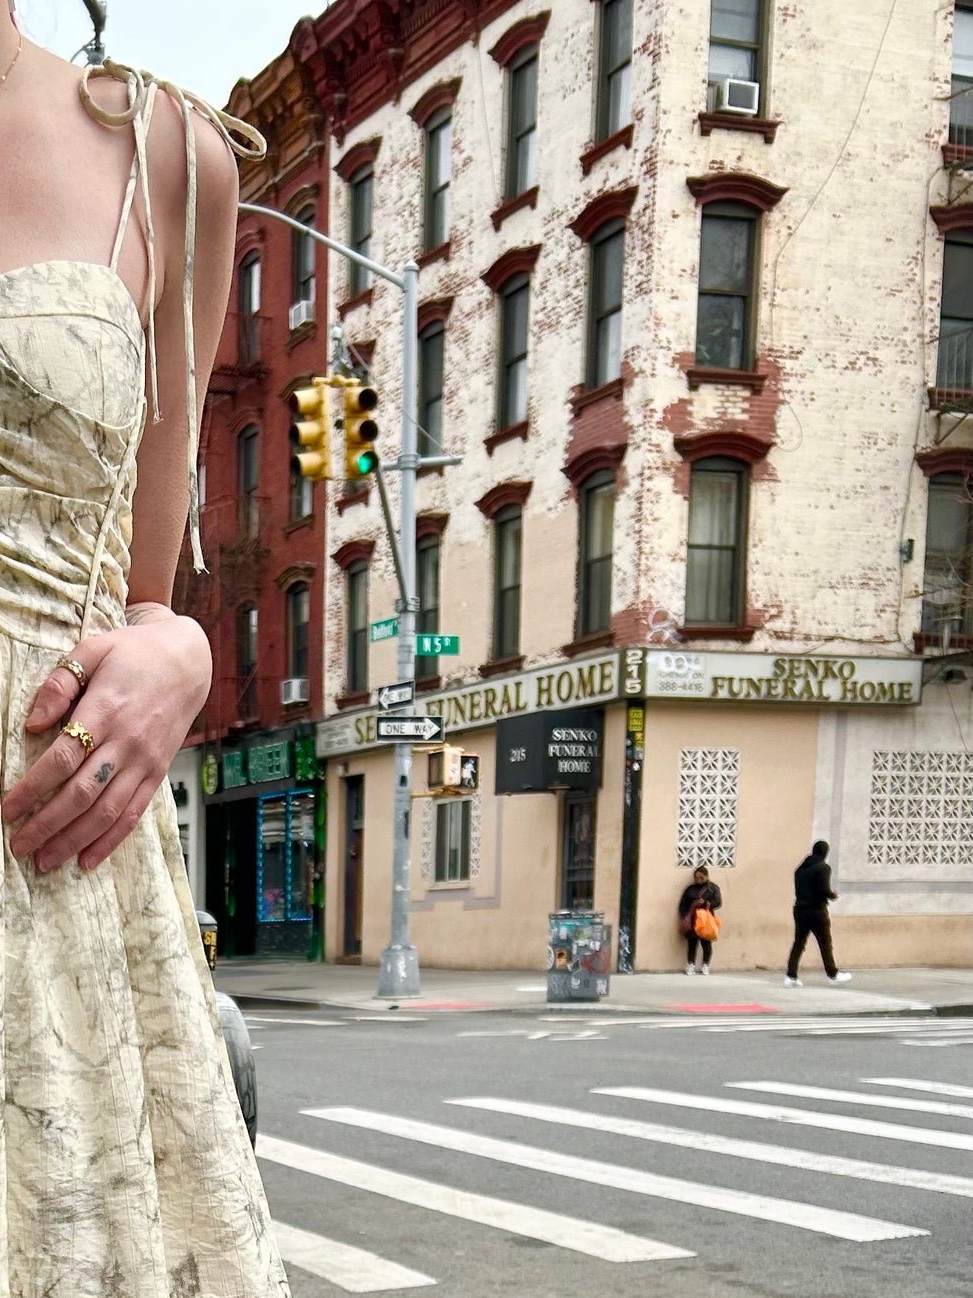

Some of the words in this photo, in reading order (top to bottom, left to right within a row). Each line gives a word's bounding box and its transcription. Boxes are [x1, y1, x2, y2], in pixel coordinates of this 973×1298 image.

[433, 637, 442, 653] 5
[773, 657, 857, 681] SENKO
[536, 660, 615, 707] HOME
[711, 676, 831, 701] FUNERAL
[840, 680, 914, 702] HOME
[386, 724, 405, 735] ONE
[414, 723, 435, 734] WAY
[552, 728, 598, 742] SENKO
[548, 744, 601, 758] FUNERAL
[557, 759, 592, 774] HOME
